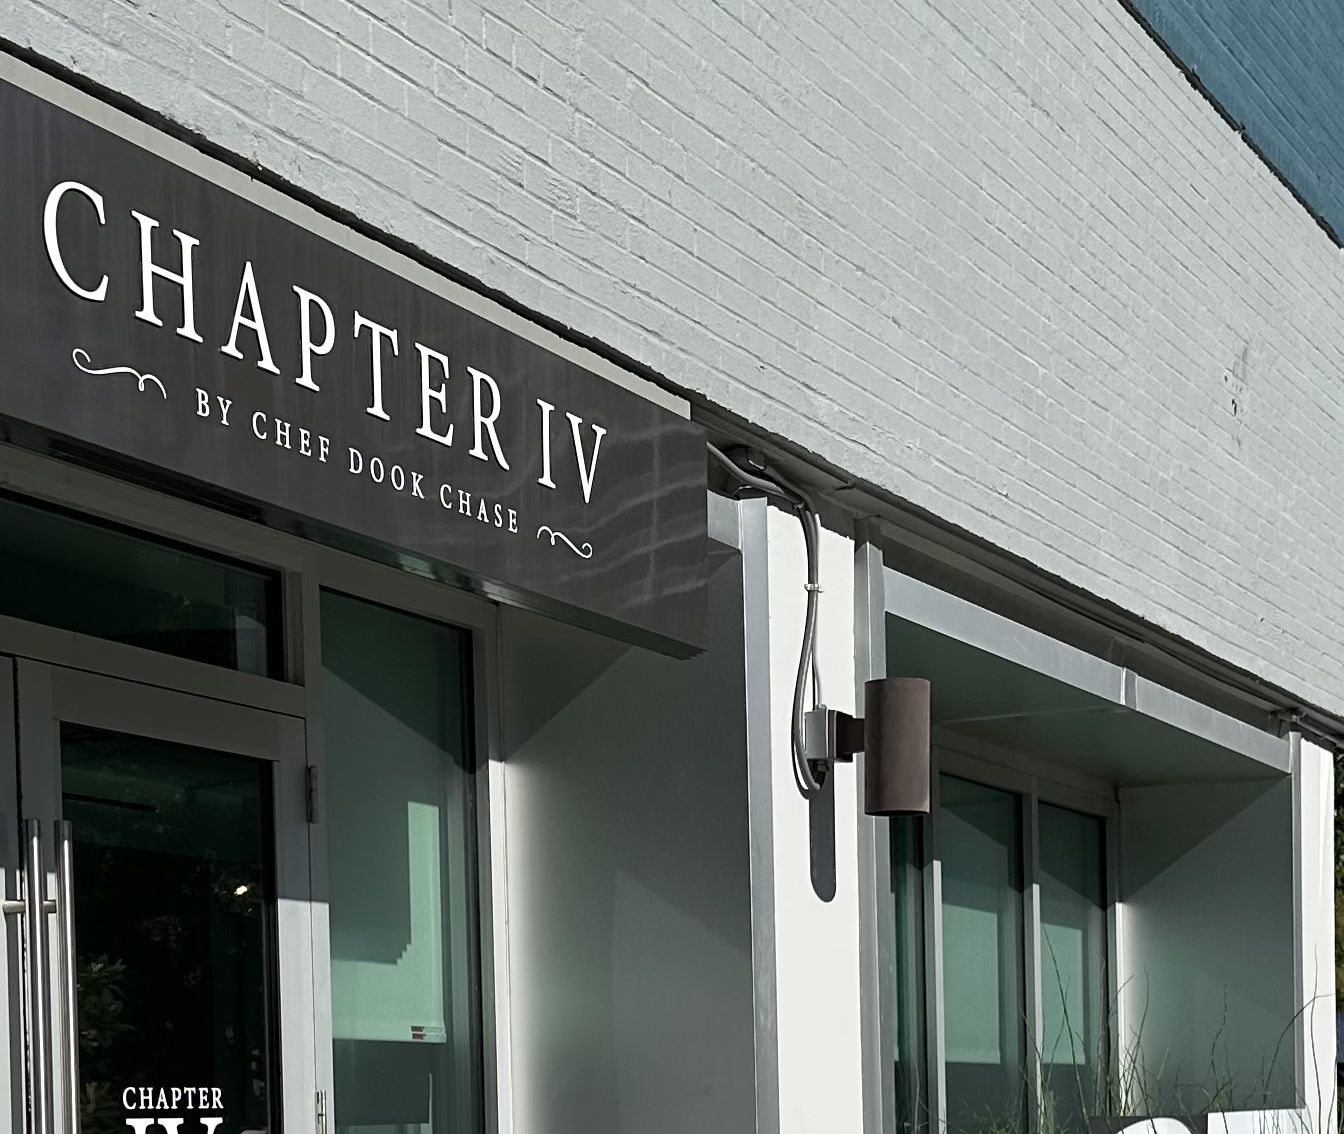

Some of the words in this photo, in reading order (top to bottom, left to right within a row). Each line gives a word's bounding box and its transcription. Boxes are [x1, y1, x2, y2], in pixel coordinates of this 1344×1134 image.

[43, 181, 510, 471] CHAPTER
[536, 398, 607, 504] IV
[195, 387, 233, 426] BY
[252, 411, 331, 463] CHEF
[348, 447, 425, 500] DOOK
[439, 483, 519, 534] CHASE
[123, 1086, 224, 1110] CHAPTER
